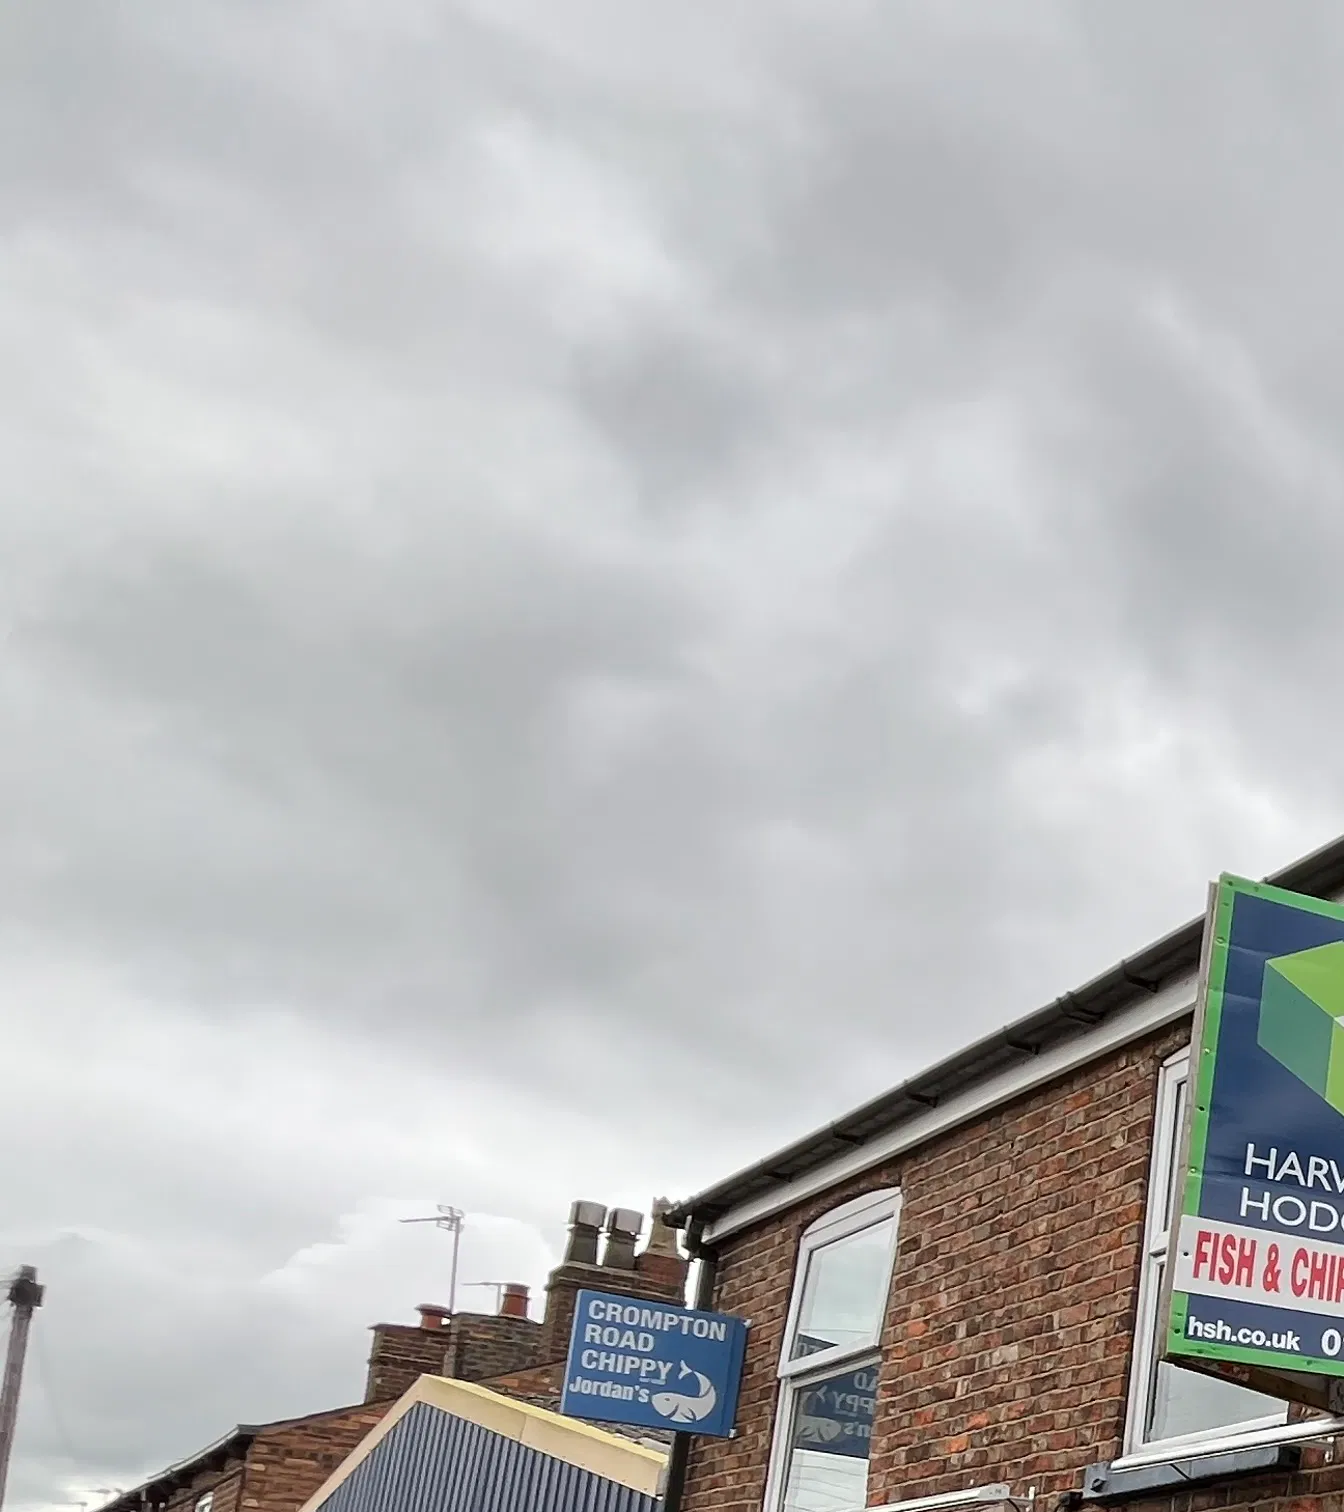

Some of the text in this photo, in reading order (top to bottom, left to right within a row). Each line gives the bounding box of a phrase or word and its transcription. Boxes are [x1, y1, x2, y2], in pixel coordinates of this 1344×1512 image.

[1192, 1230, 1257, 1288] FISH
[1262, 1243, 1281, 1294] &
[588, 1300, 727, 1341] CROMPTON
[1188, 1316, 1301, 1351] hsh.co.uk
[584, 1323, 655, 1352] ROAD
[581, 1349, 673, 1381] CHIPPY
[569, 1375, 650, 1404] Jordan's
